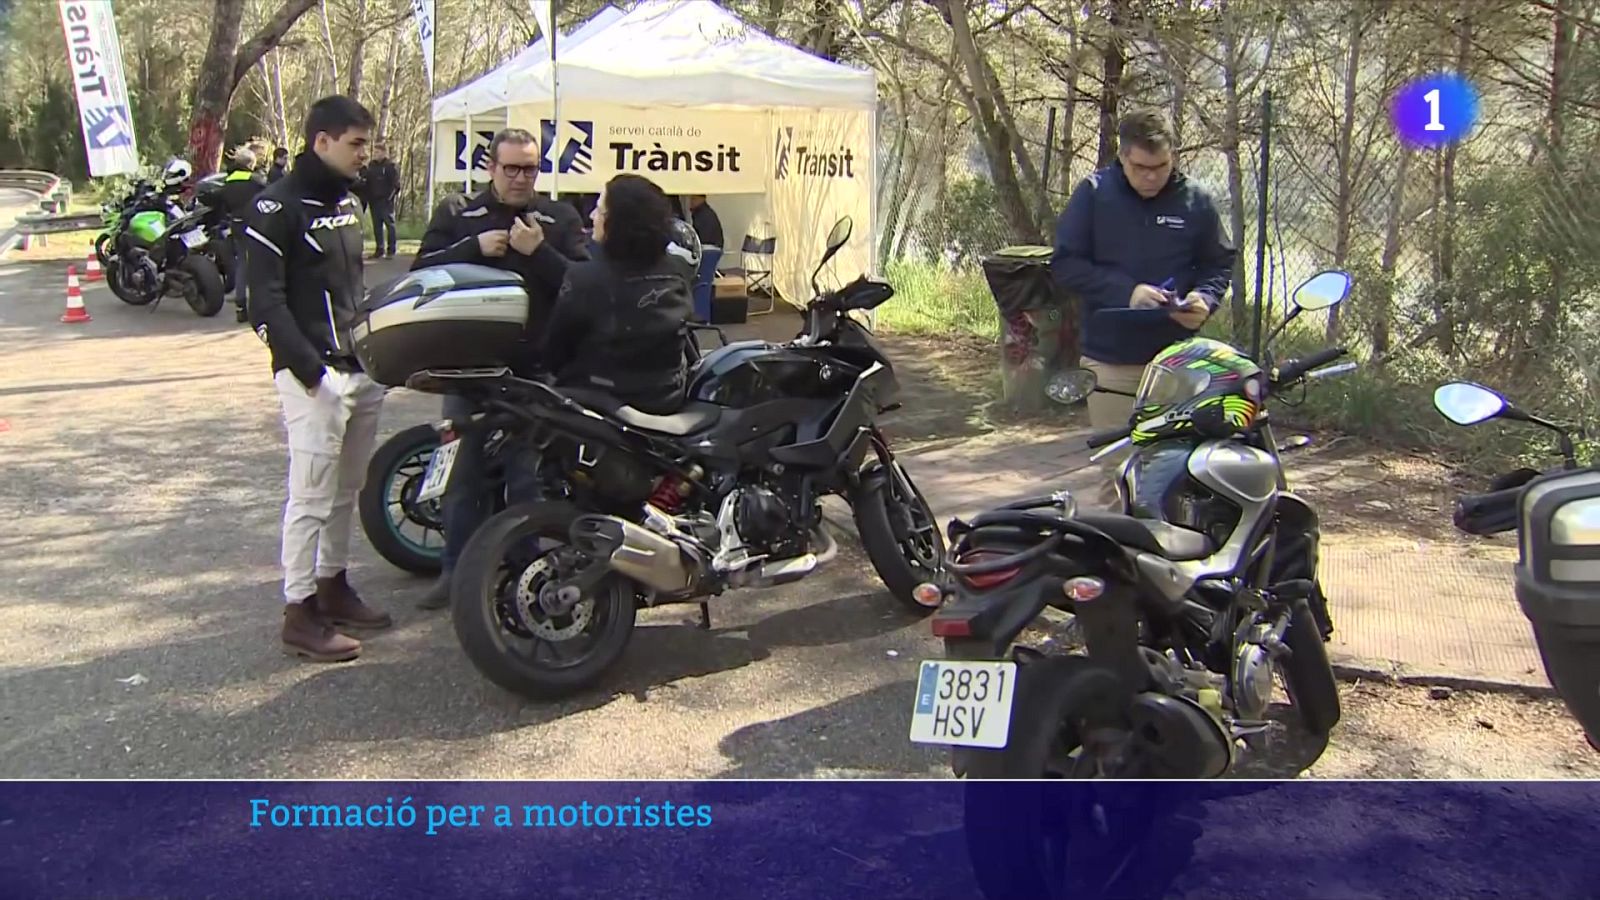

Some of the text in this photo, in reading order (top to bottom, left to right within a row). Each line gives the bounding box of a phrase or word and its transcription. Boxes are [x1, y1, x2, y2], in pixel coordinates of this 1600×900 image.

[609, 124, 702, 137] servei català de
[609, 142, 741, 172] Trànsit
[796, 145, 854, 178] Trànsit
[939, 668, 1005, 703] 3831
[933, 705, 985, 739] HSV
